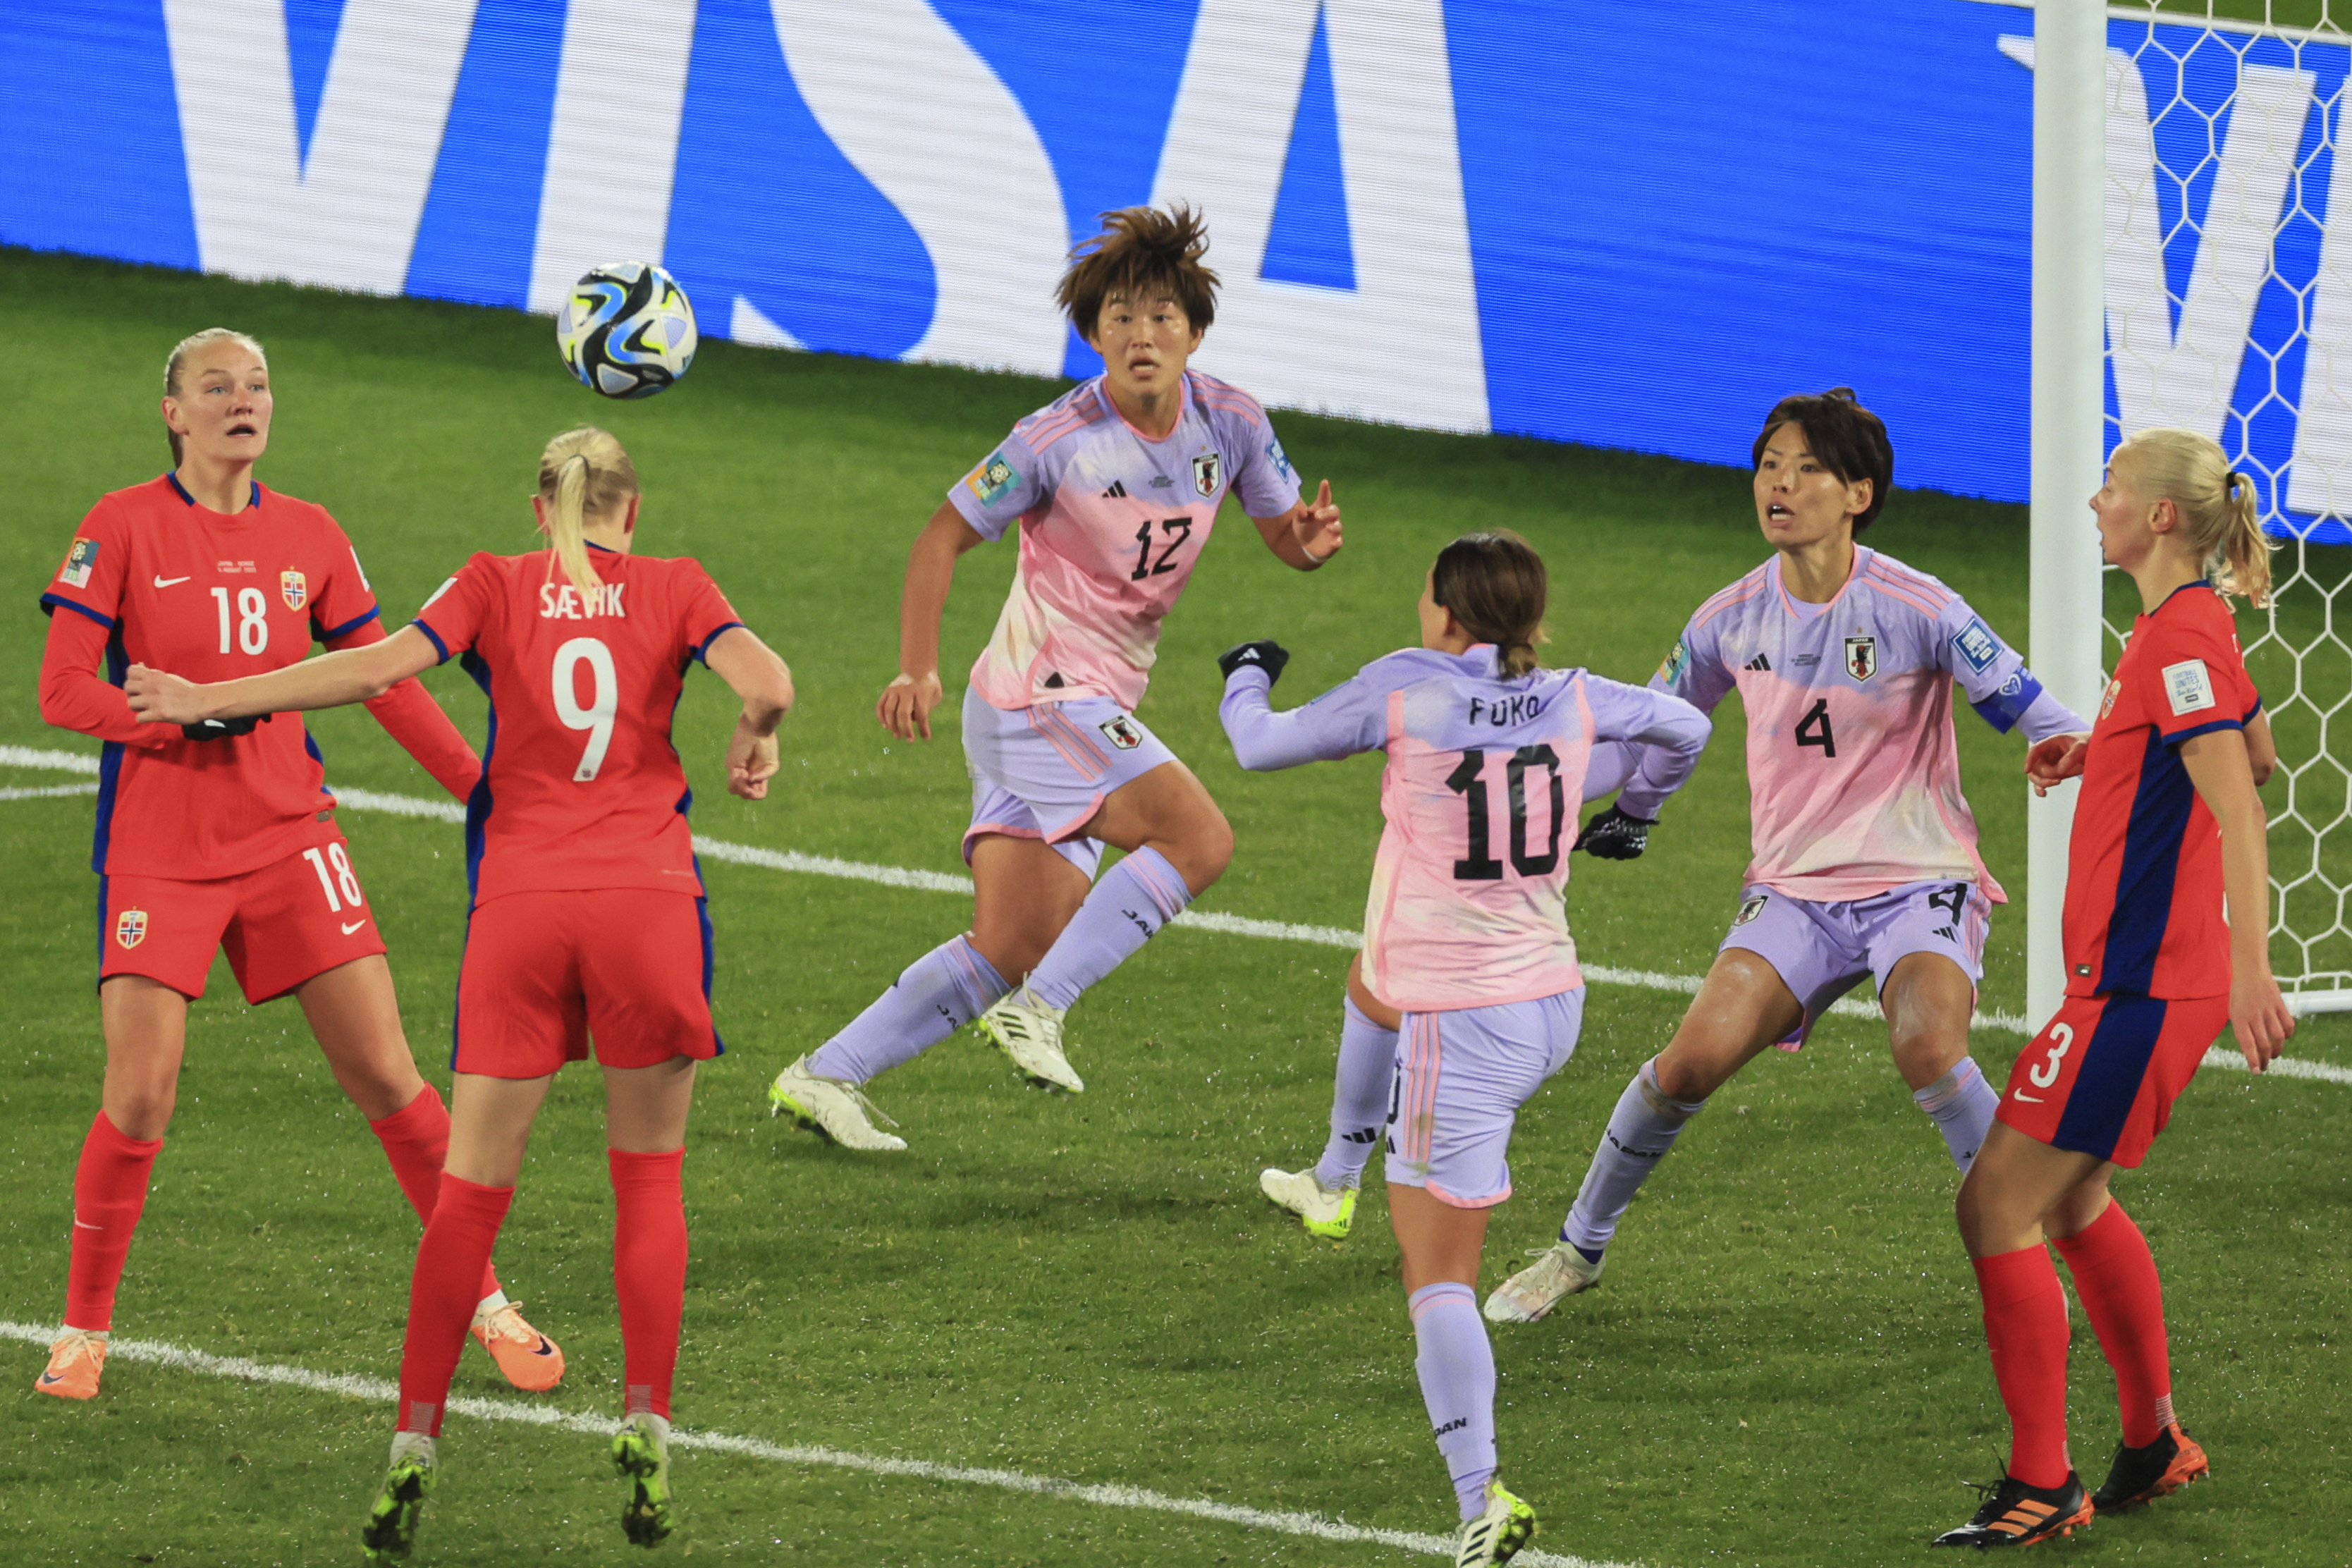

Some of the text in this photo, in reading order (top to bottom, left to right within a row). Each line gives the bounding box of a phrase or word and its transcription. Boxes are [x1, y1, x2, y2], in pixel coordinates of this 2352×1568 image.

[163, 0, 1492, 435] VISA
[1131, 517, 1192, 581] 12
[210, 587, 269, 656] 18
[551, 637, 618, 783] 9
[1794, 698, 1836, 758] 4
[1445, 744, 1564, 880] 10
[303, 842, 362, 912] 18
[1928, 883, 1968, 927] 4
[2029, 1022, 2074, 1088] 3
